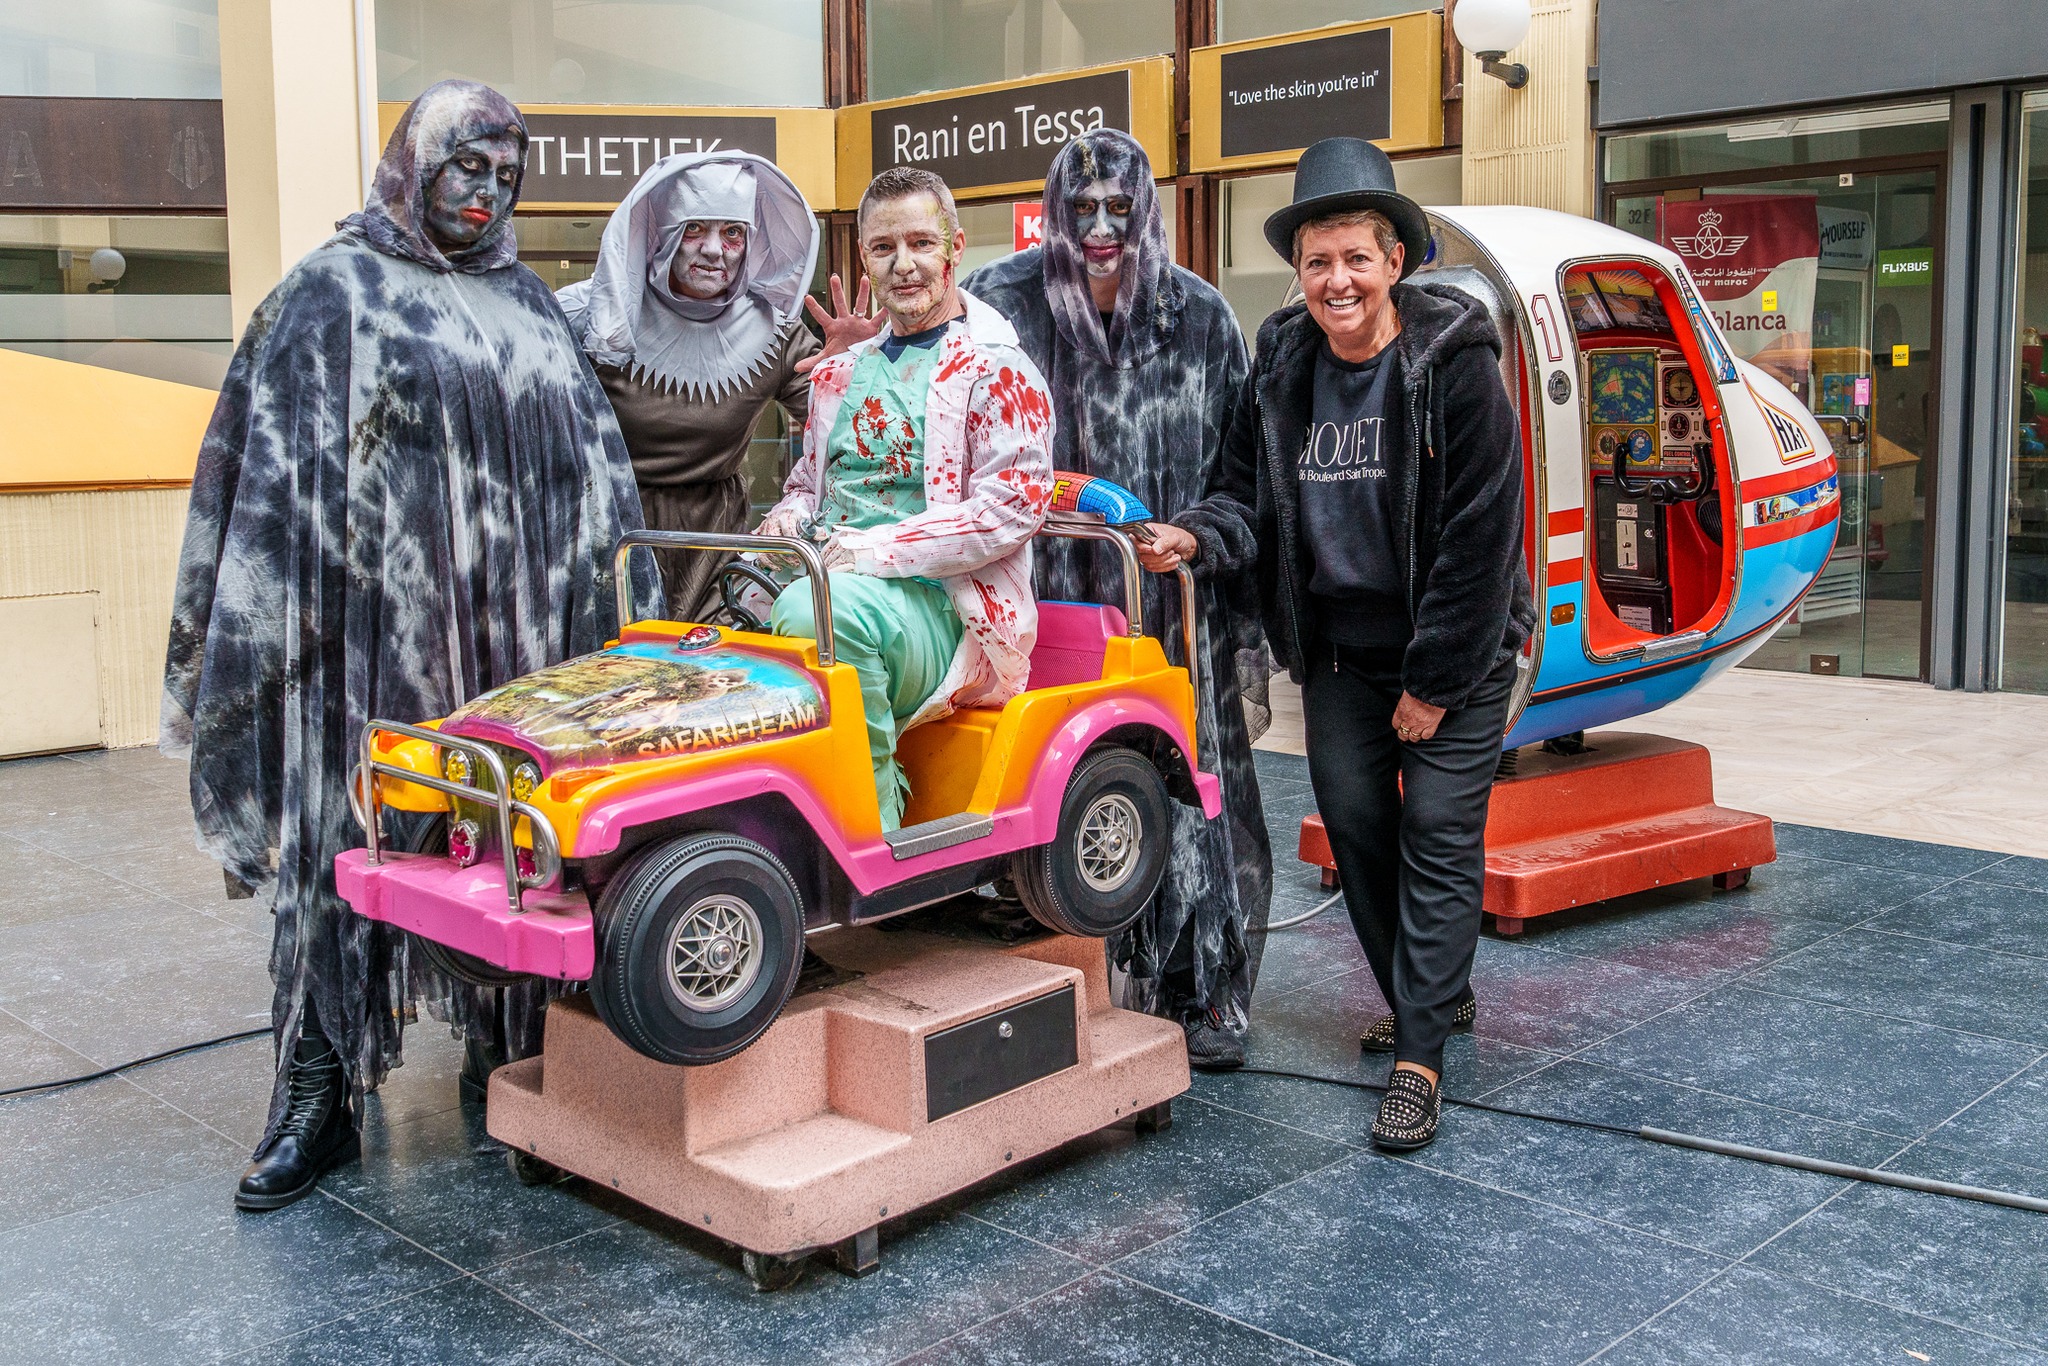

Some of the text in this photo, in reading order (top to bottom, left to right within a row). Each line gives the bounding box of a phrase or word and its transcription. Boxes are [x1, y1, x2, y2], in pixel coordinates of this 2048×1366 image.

[1264, 84, 1286, 101] the
[1288, 80, 1315, 98] skin
[1317, 75, 1359, 98] you're
[894, 104, 1104, 164] Rani en Tessa
[1628, 209, 1642, 225] 32
[1825, 221, 1867, 245] YOURSELF
[1695, 279, 1749, 287] air maroc
[638, 703, 818, 757] SAFARI-TEAM
